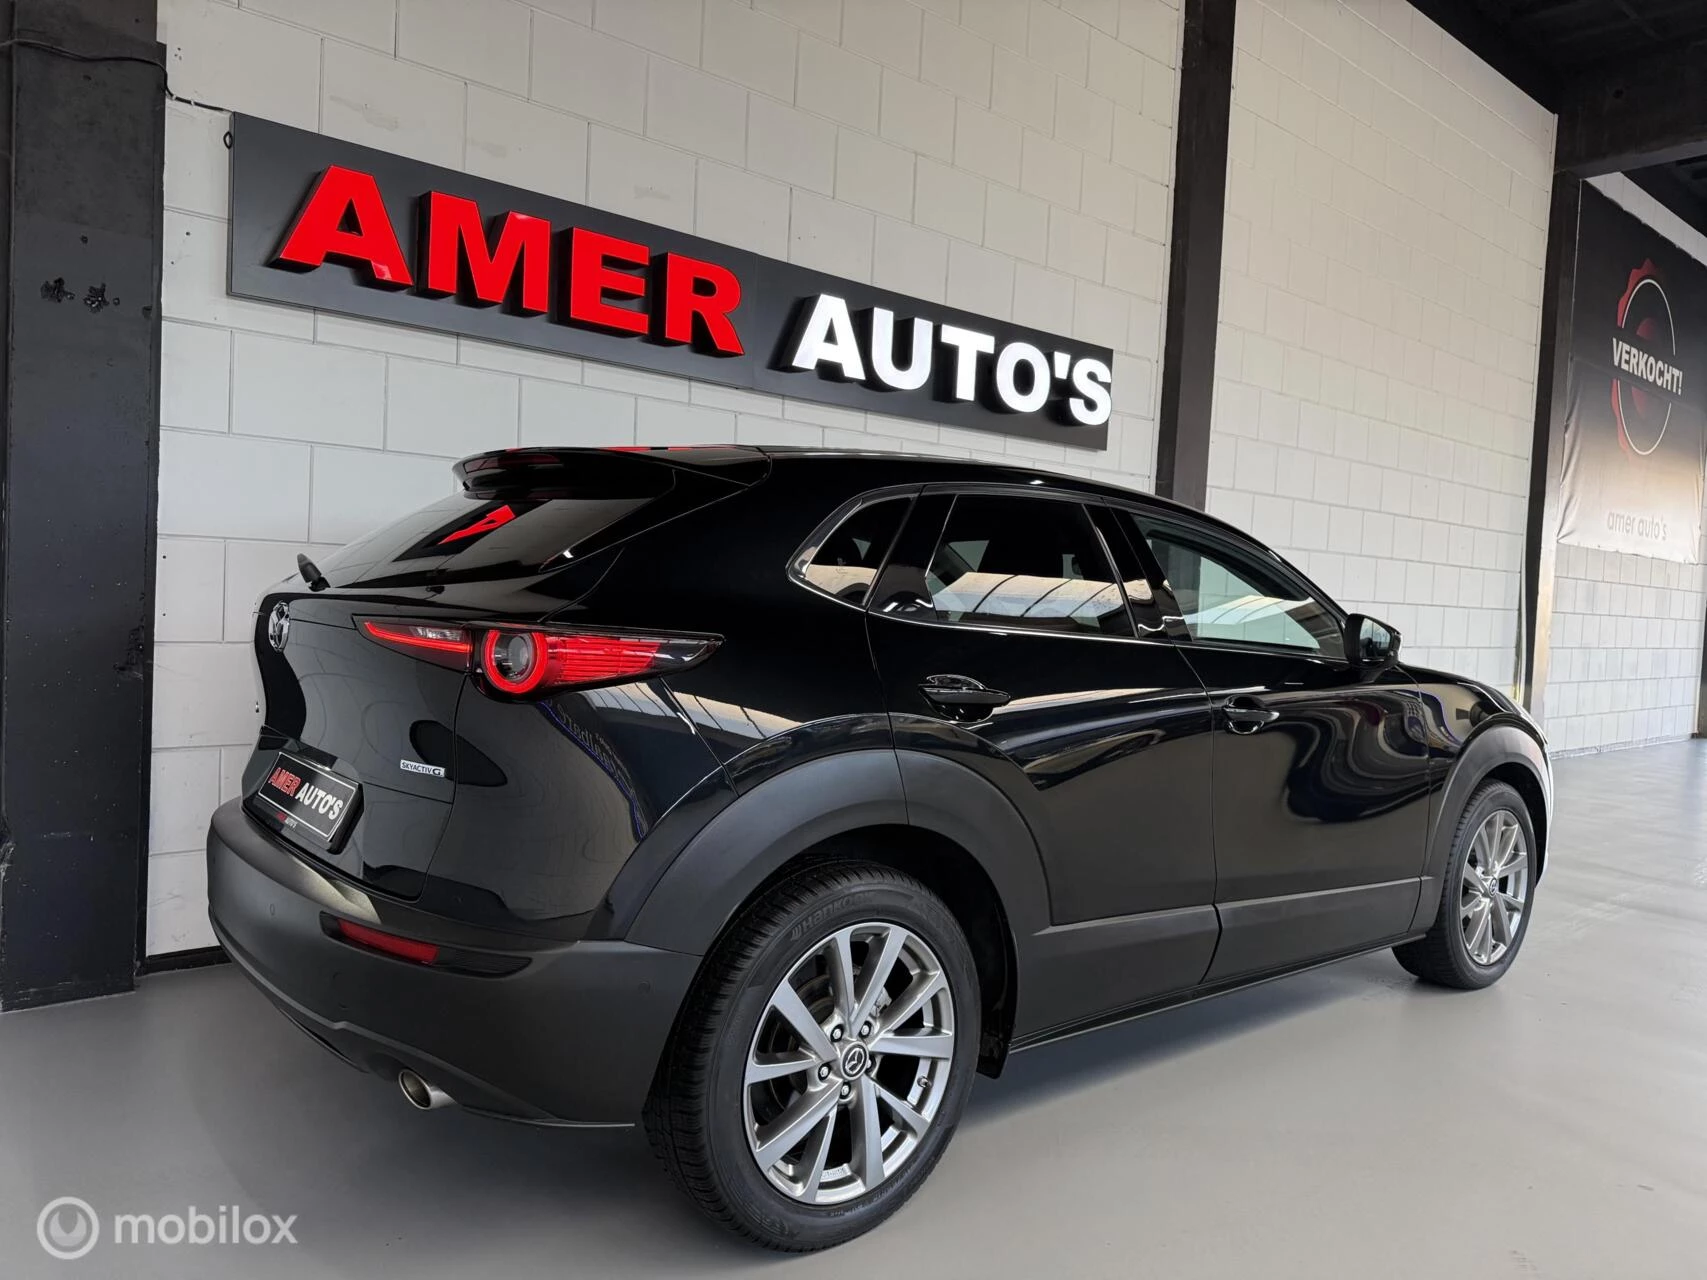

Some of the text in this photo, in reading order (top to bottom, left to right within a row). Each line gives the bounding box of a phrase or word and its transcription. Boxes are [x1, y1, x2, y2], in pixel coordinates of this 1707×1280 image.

[277, 164, 1113, 426] AMER AUTO'S
[1612, 337, 1684, 396] VERKOCHT!
[1606, 511, 1668, 541] amer auto's
[267, 766, 301, 797] AMER
[296, 782, 344, 820] AUTO'S
[401, 761, 433, 774] SKYACTIV
